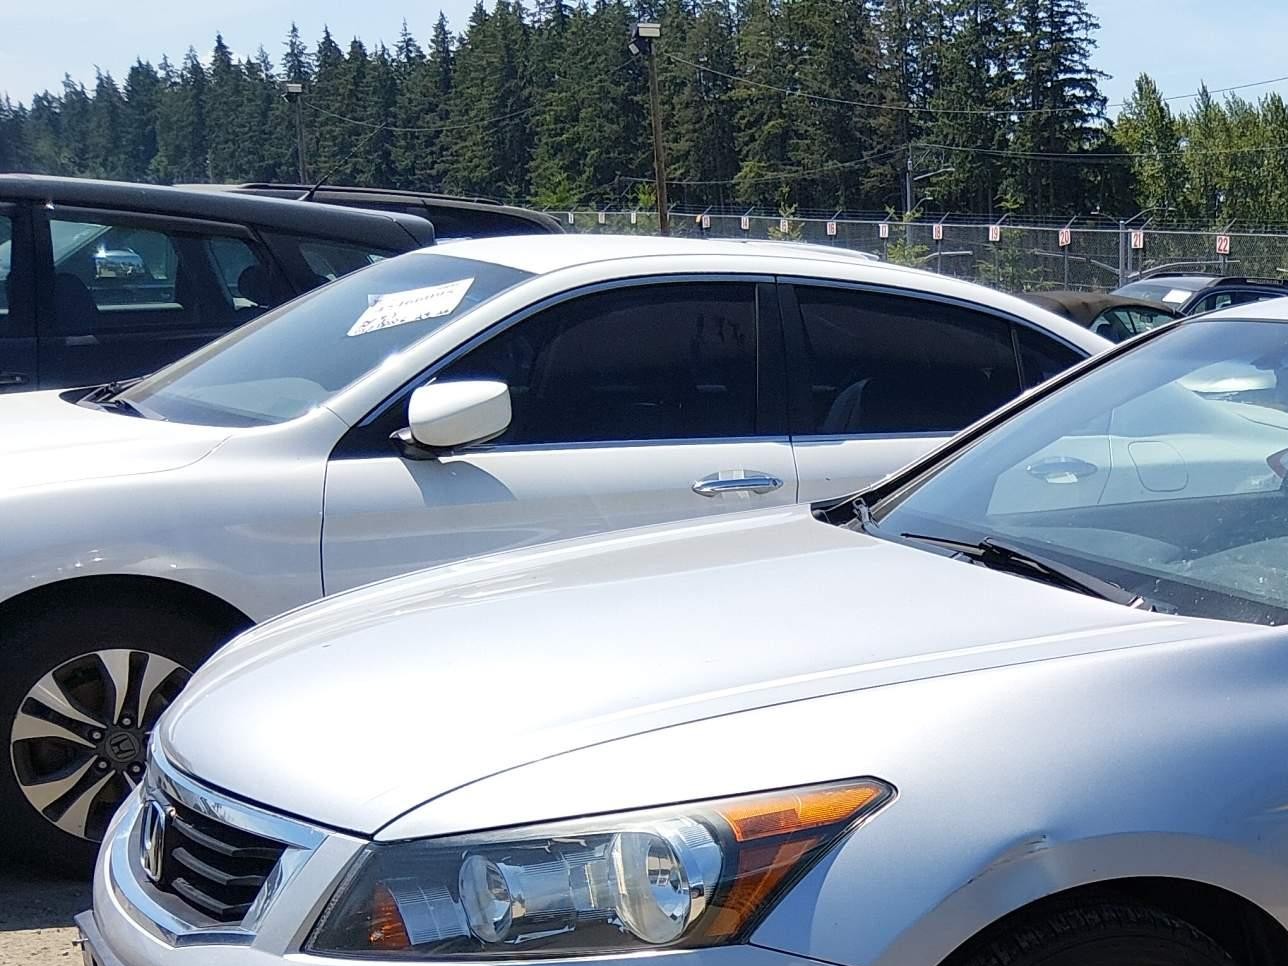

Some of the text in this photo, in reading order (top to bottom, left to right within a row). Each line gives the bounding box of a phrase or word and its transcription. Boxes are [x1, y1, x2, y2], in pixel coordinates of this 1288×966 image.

[934, 225, 941, 238] 18
[991, 227, 998, 240] 19
[1060, 230, 1069, 245] 20
[1133, 232, 1141, 247] 21
[1217, 237, 1228, 252] 22
